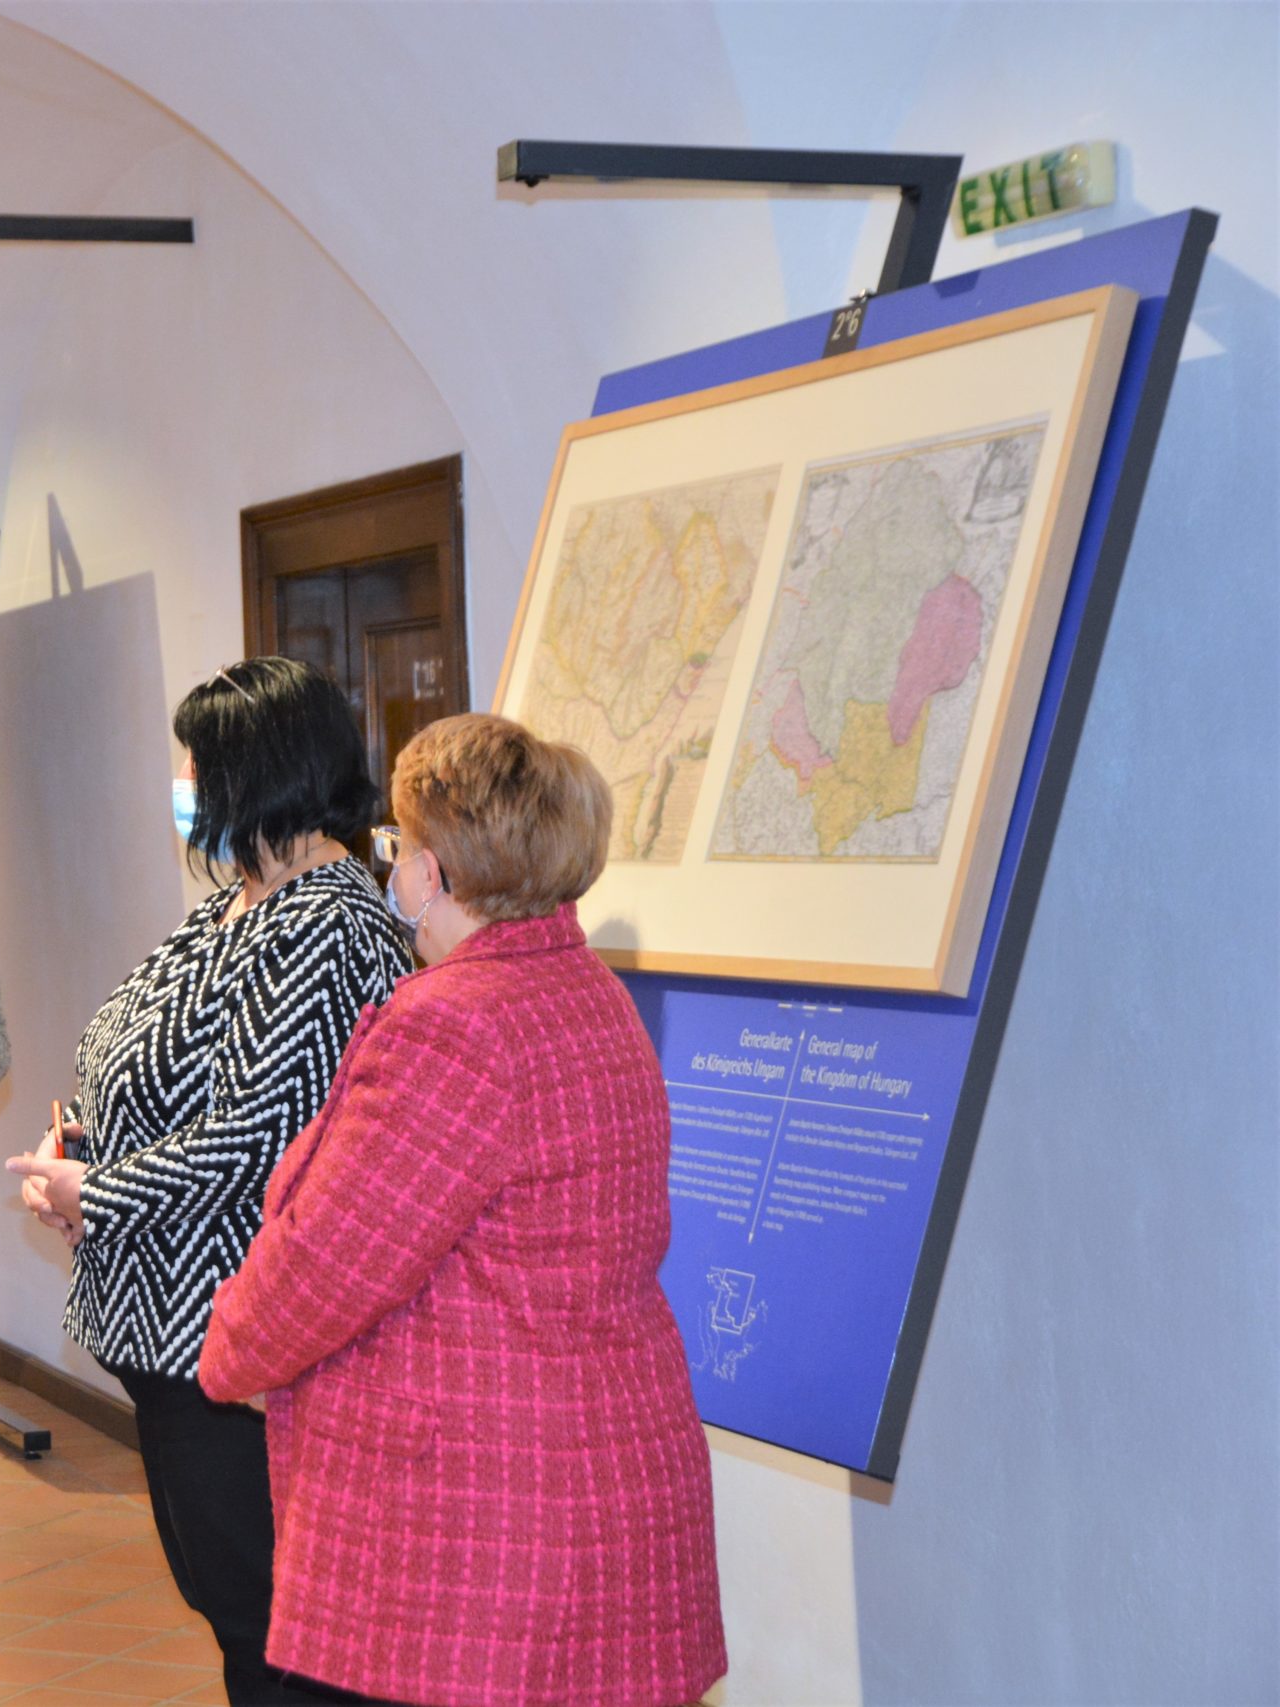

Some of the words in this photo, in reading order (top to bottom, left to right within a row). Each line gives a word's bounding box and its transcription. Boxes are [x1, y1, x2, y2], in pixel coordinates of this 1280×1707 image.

[960, 150, 1066, 236] EXIT
[739, 1027, 794, 1053] Generalkarte
[807, 1034, 844, 1057] General
[842, 1044, 865, 1064] map
[864, 1041, 880, 1061] of
[691, 1052, 707, 1071] des
[706, 1053, 753, 1078] Königreichs
[753, 1058, 786, 1083] Ungarn
[800, 1065, 818, 1084] the
[817, 1066, 858, 1091] Kingdom
[858, 1071, 871, 1090] of
[869, 1071, 913, 1098] Hungary
